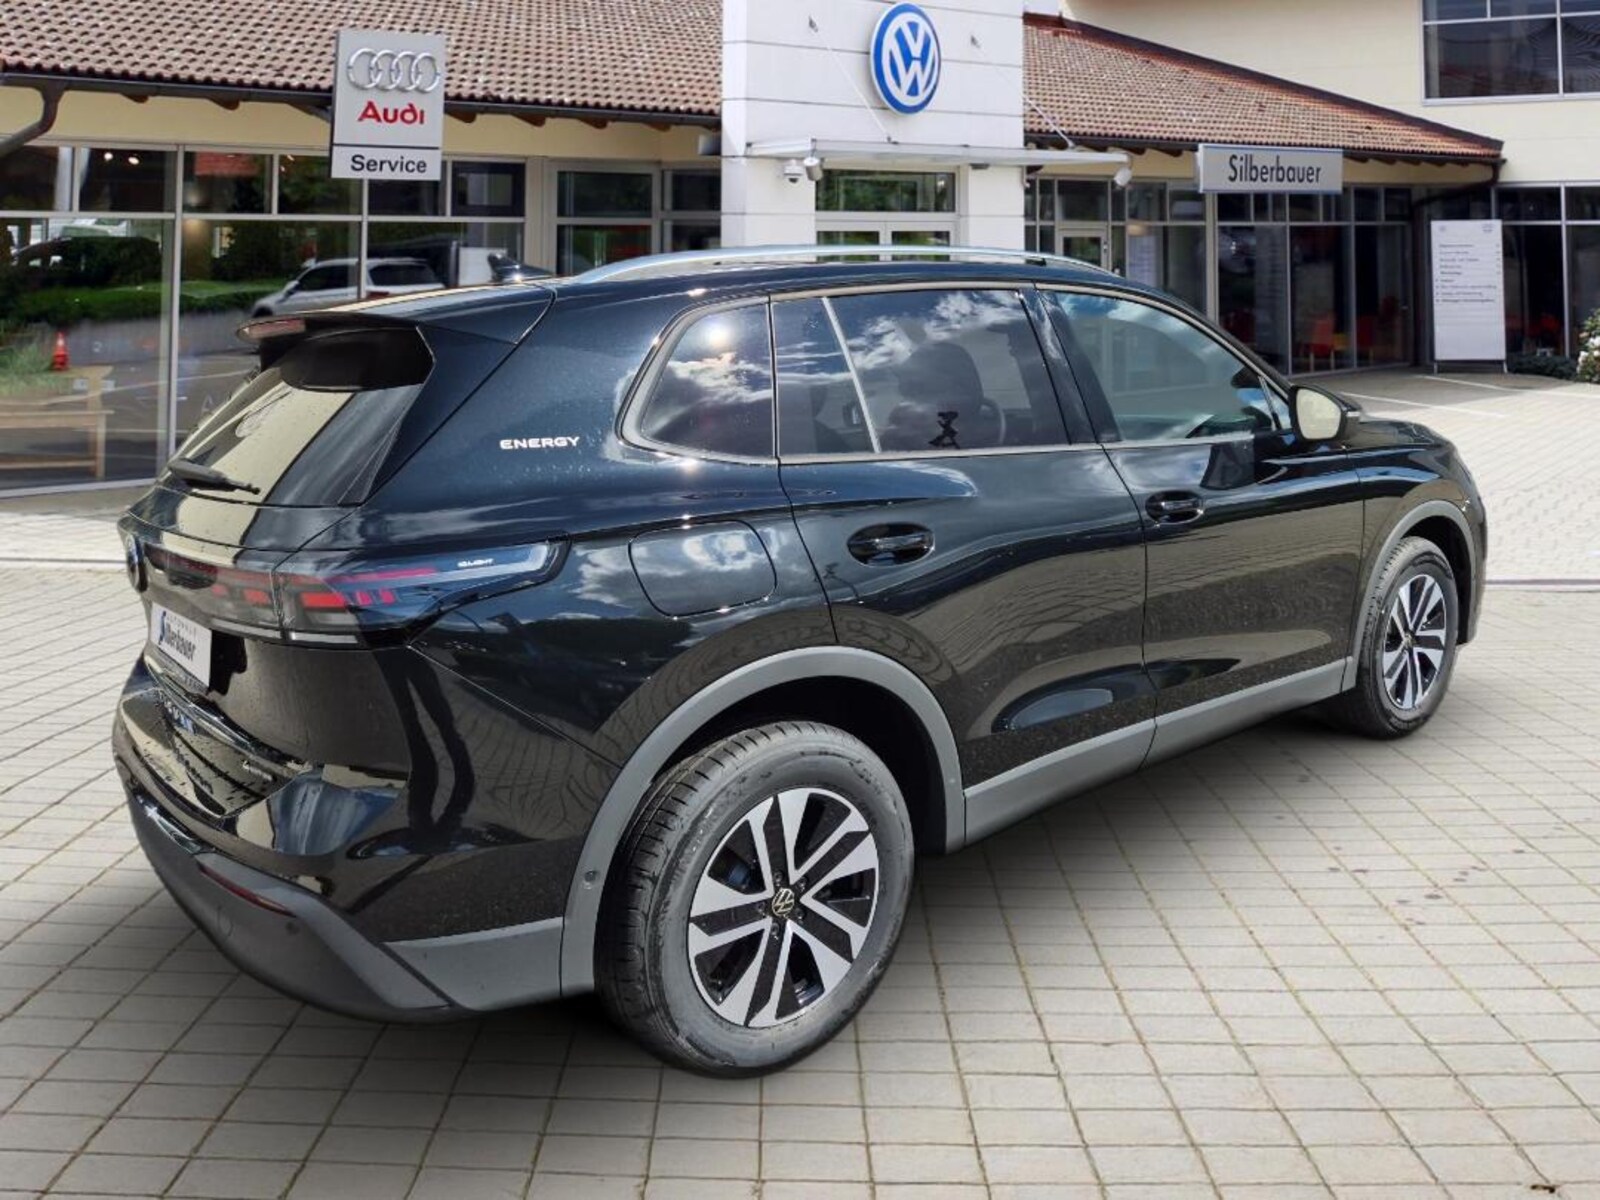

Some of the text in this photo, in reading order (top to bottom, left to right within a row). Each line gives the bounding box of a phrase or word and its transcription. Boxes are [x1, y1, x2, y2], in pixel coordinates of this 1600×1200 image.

[357, 101, 425, 125] Audi
[350, 154, 427, 173] Service
[1228, 154, 1321, 183] Silberbauer
[500, 436, 580, 450] ENERGY
